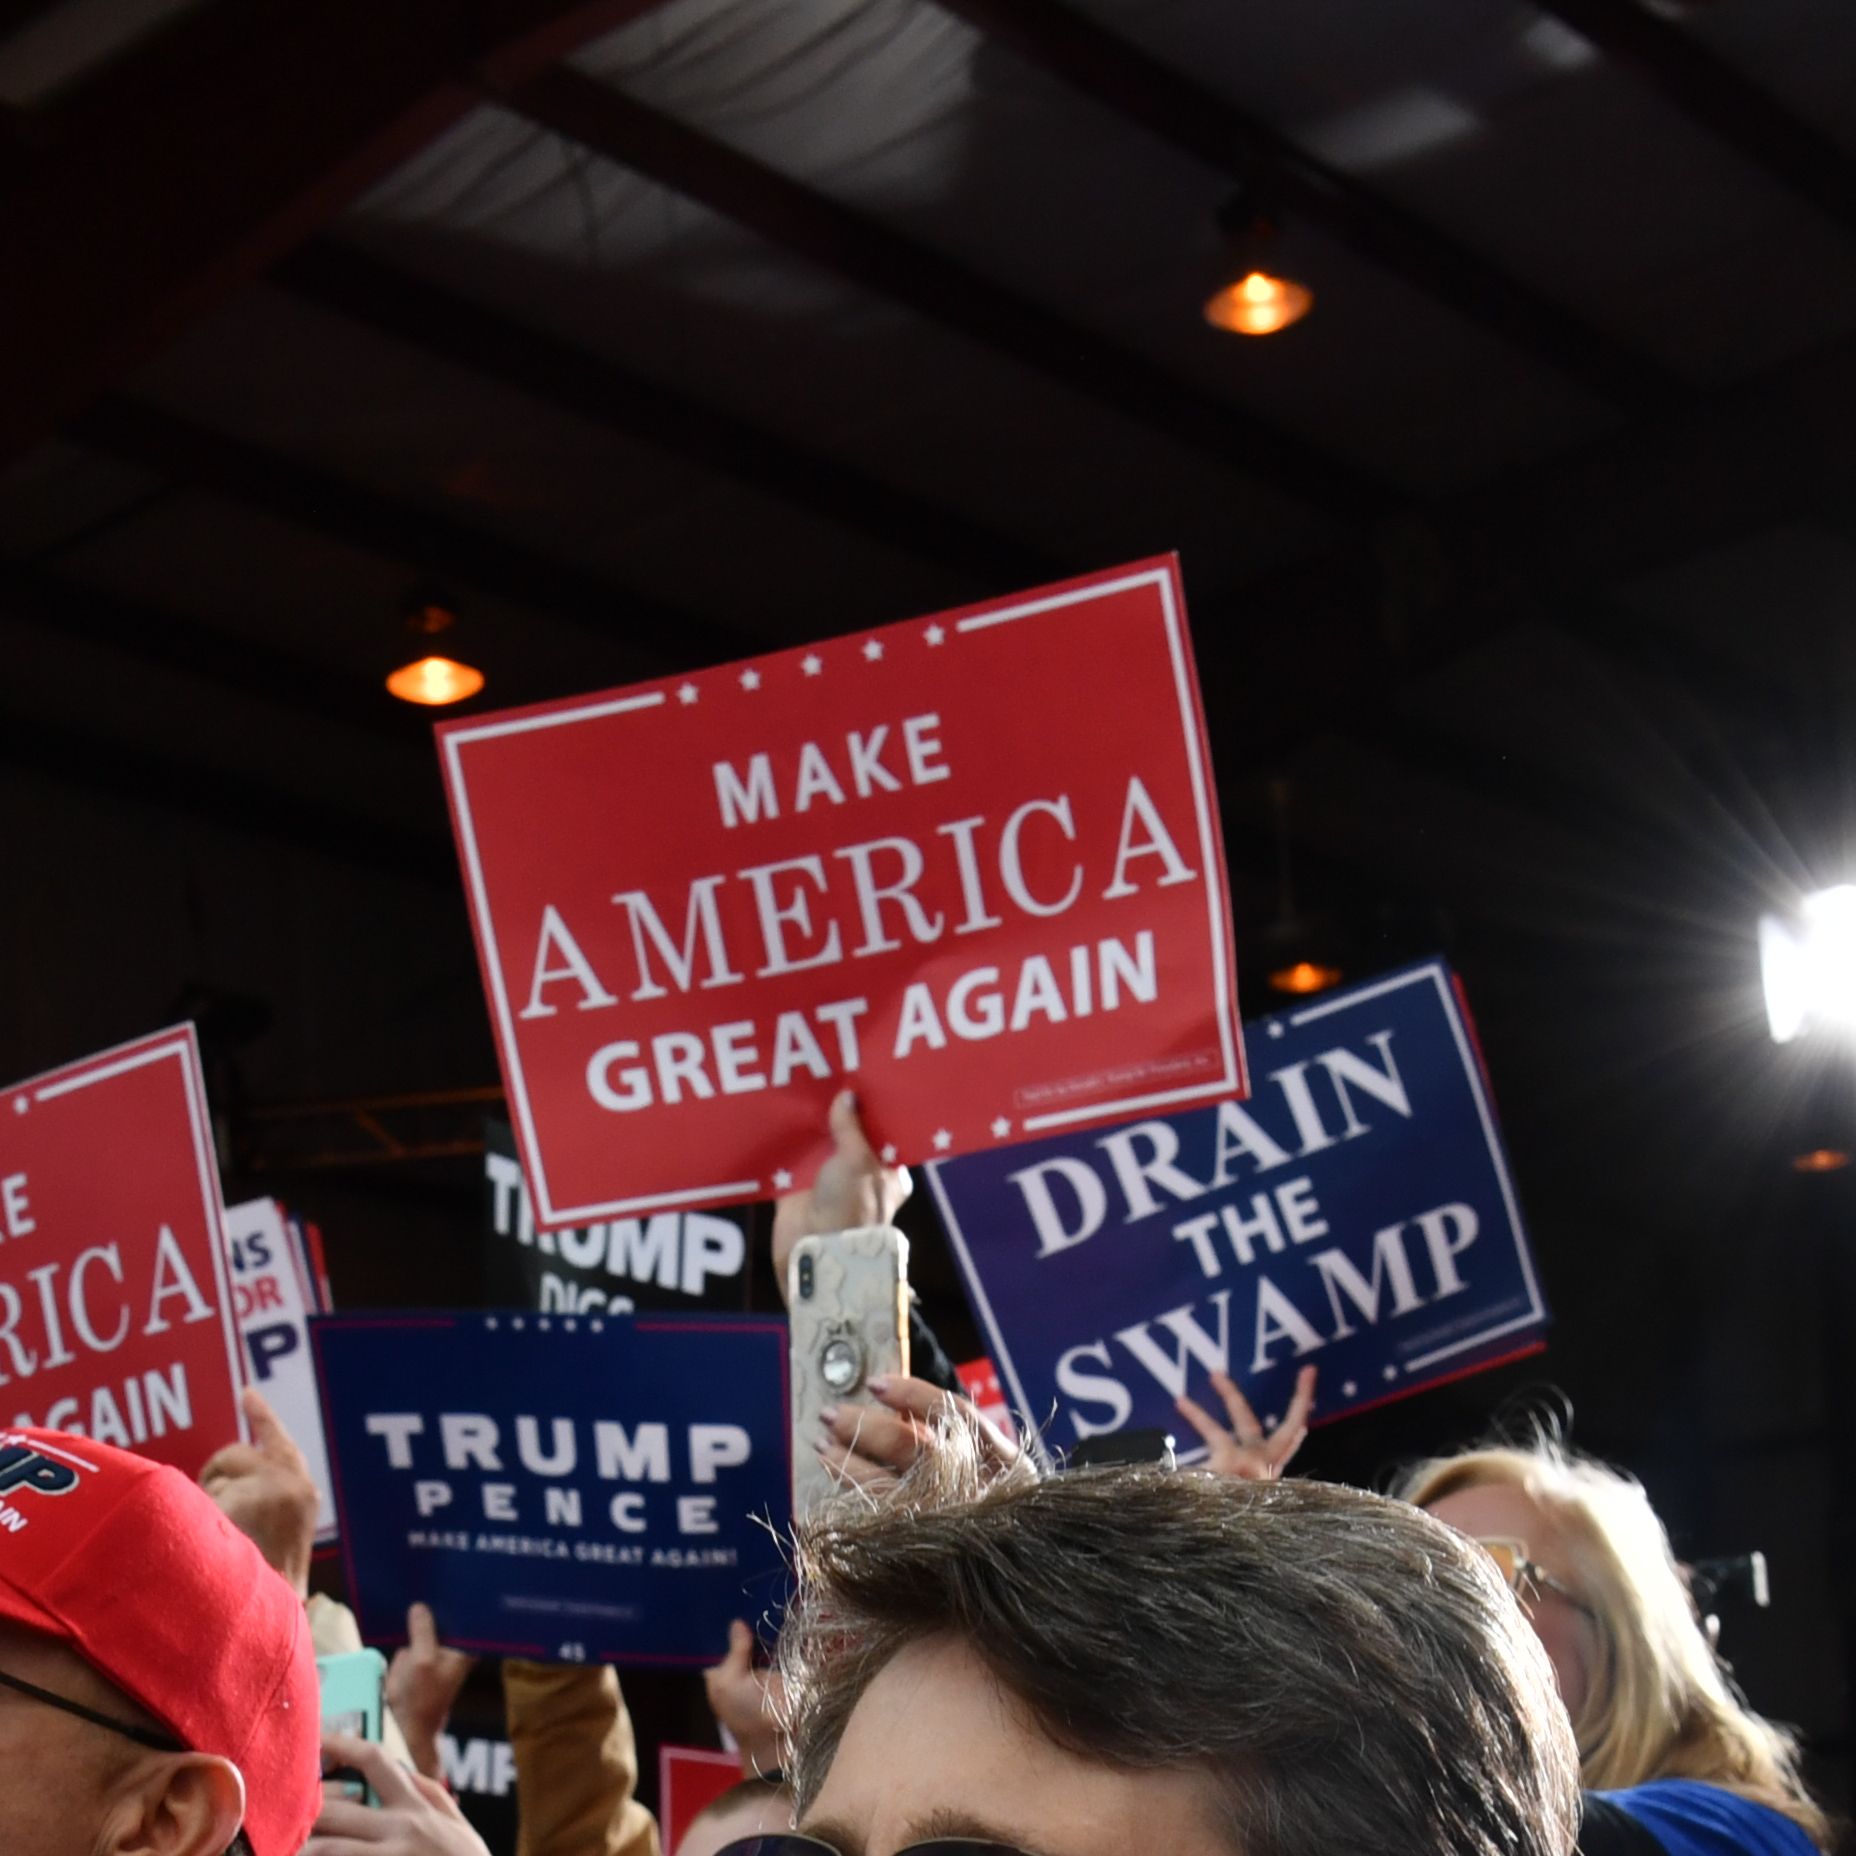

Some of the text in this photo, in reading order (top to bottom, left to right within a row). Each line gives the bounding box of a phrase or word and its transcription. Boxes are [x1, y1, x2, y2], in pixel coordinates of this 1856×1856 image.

[712, 713, 951, 829] MAKE
[519, 775, 1197, 1021] AMERICA
[585, 998, 868, 1112] GREAT
[893, 930, 1158, 1060] AGAIN
[1006, 1029, 1413, 1260] DRAIN
[1172, 1177, 1330, 1279] THE
[1054, 1202, 1481, 1442] SWAMP
[365, 1412, 753, 1485] TRUMP
[407, 1529, 471, 1552] MAKE
[475, 1533, 571, 1561] AMERICA
[574, 1542, 644, 1567] GREAT
[414, 1480, 720, 1535] PENCE
